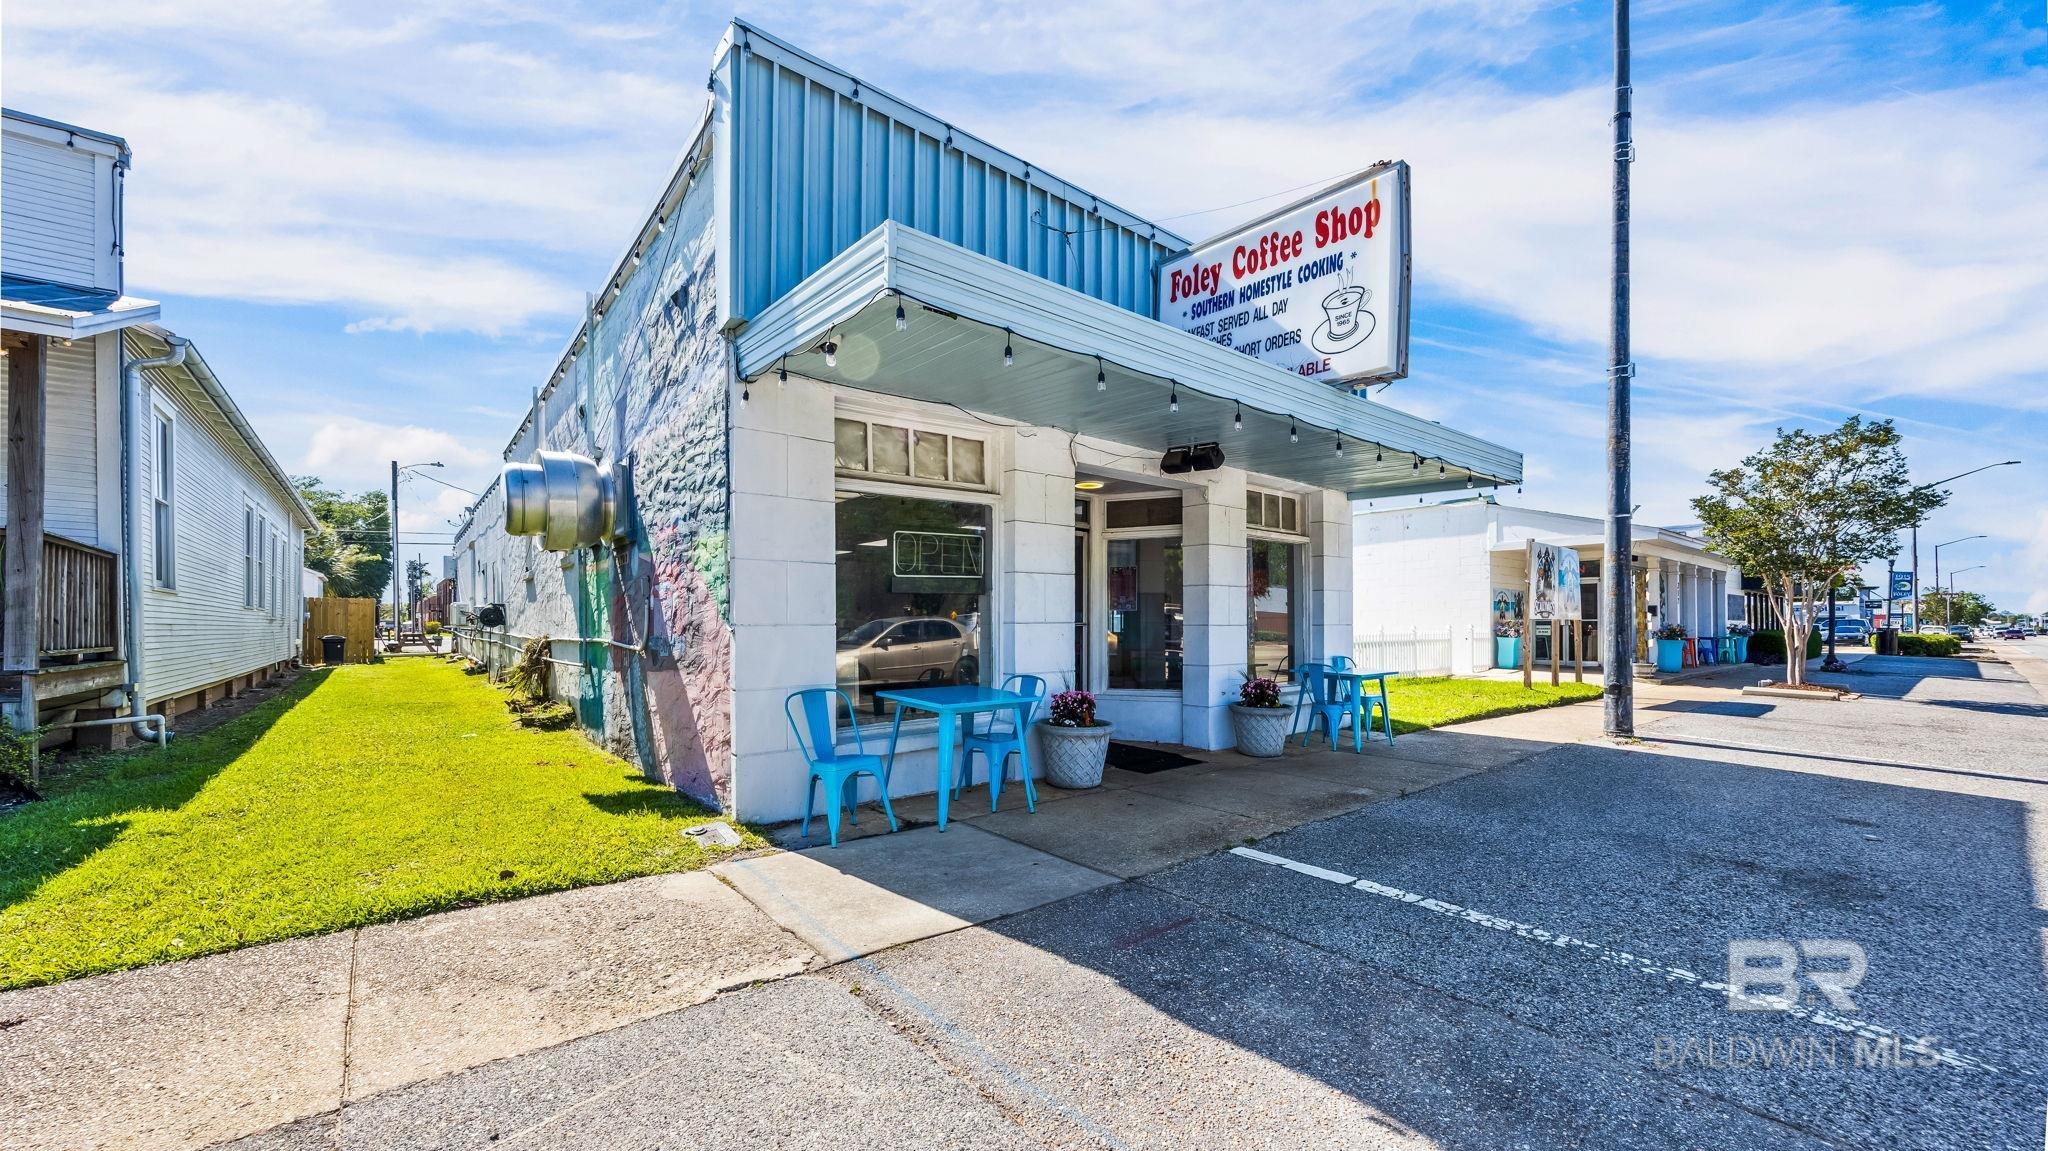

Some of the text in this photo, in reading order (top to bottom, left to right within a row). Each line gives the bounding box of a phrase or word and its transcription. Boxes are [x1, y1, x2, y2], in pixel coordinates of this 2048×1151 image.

[1170, 198, 1381, 303] Foley Coffee Shop
[1191, 251, 1343, 320] SOUTHERN HOMESTYLE COOKING
[1218, 311, 1250, 333] SERVED
[1253, 305, 1269, 323] ALL
[1272, 298, 1289, 316] DAY
[1335, 311, 1352, 322] SINCE
[1265, 328, 1301, 352] ORDERS
[1298, 357, 1331, 377] ABLE
[896, 532, 983, 575] OPEN
